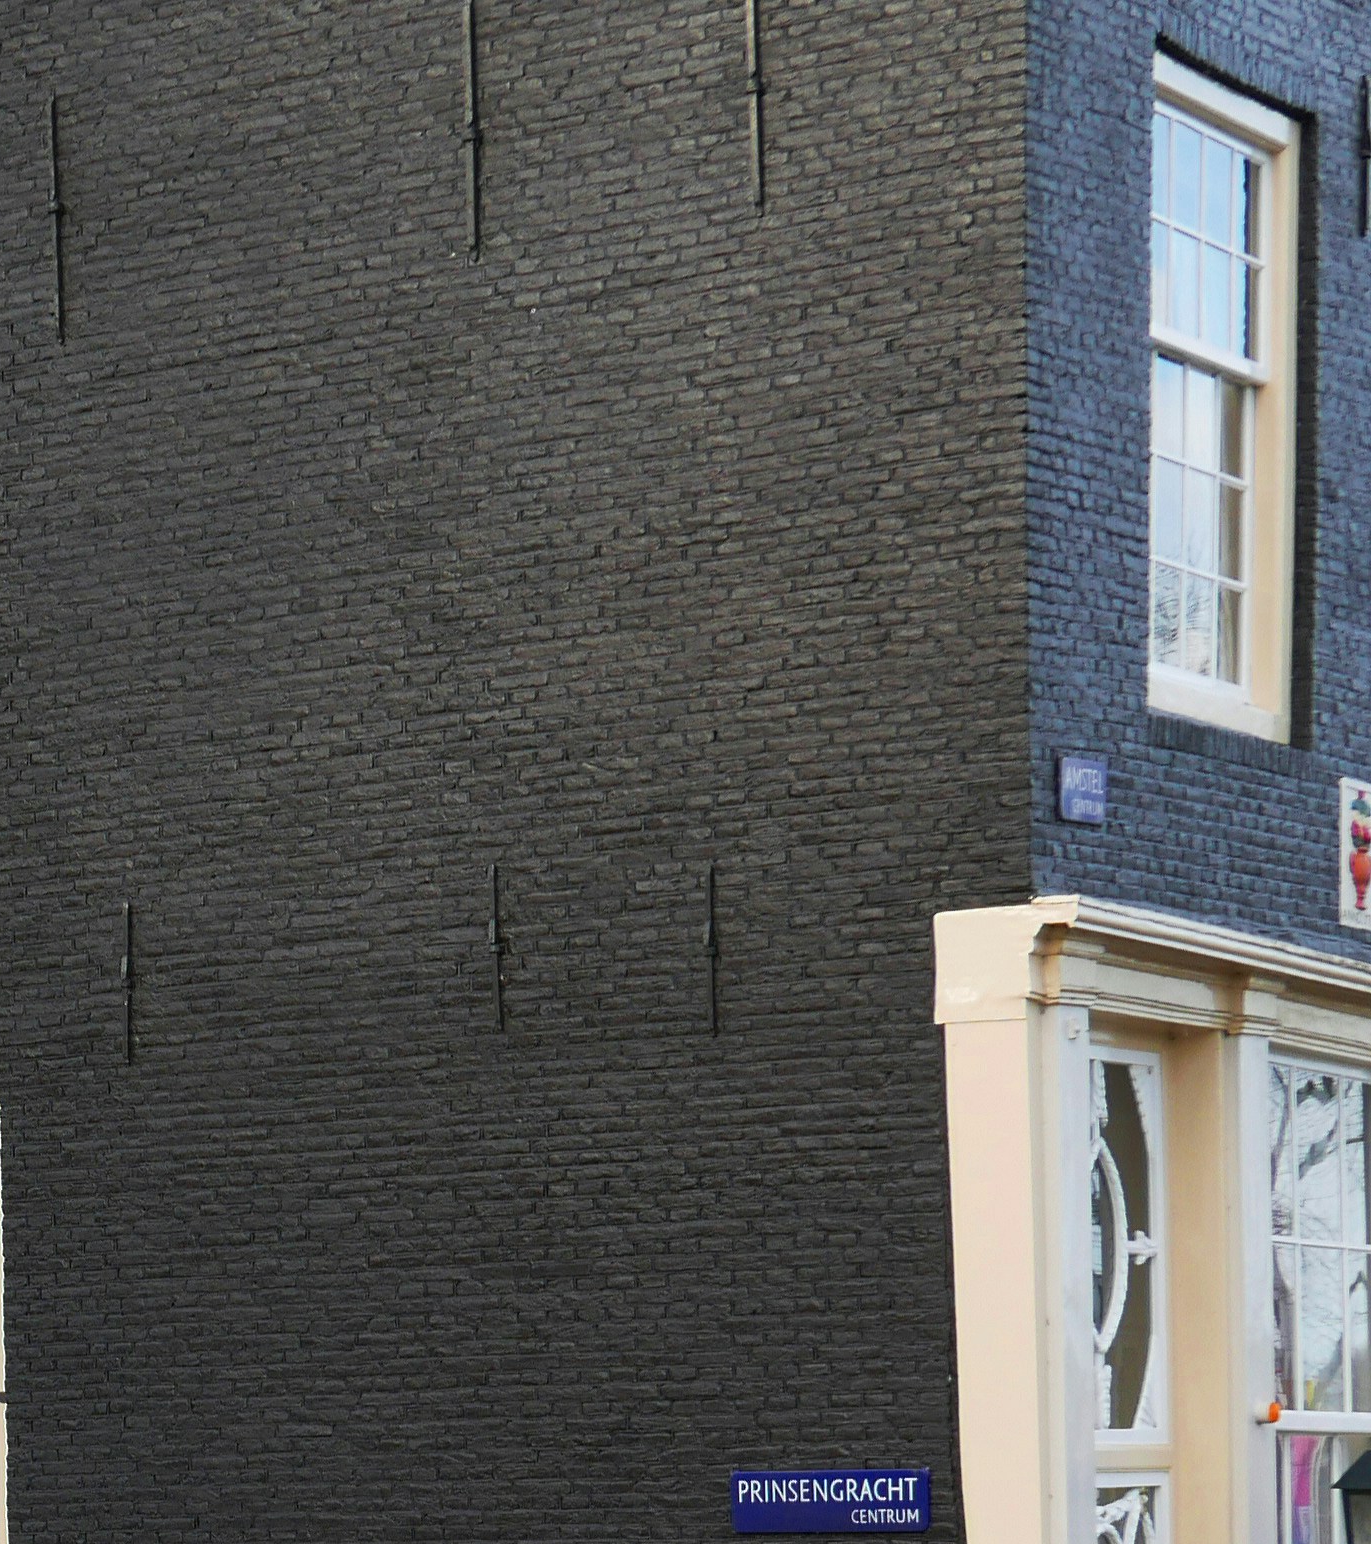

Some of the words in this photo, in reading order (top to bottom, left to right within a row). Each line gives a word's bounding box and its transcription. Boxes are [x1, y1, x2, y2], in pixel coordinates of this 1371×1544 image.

[1063, 766, 1104, 794] AMSTEL
[737, 1477, 918, 1503] PRINSENGRACHT
[850, 1508, 920, 1524] CENTRUM
